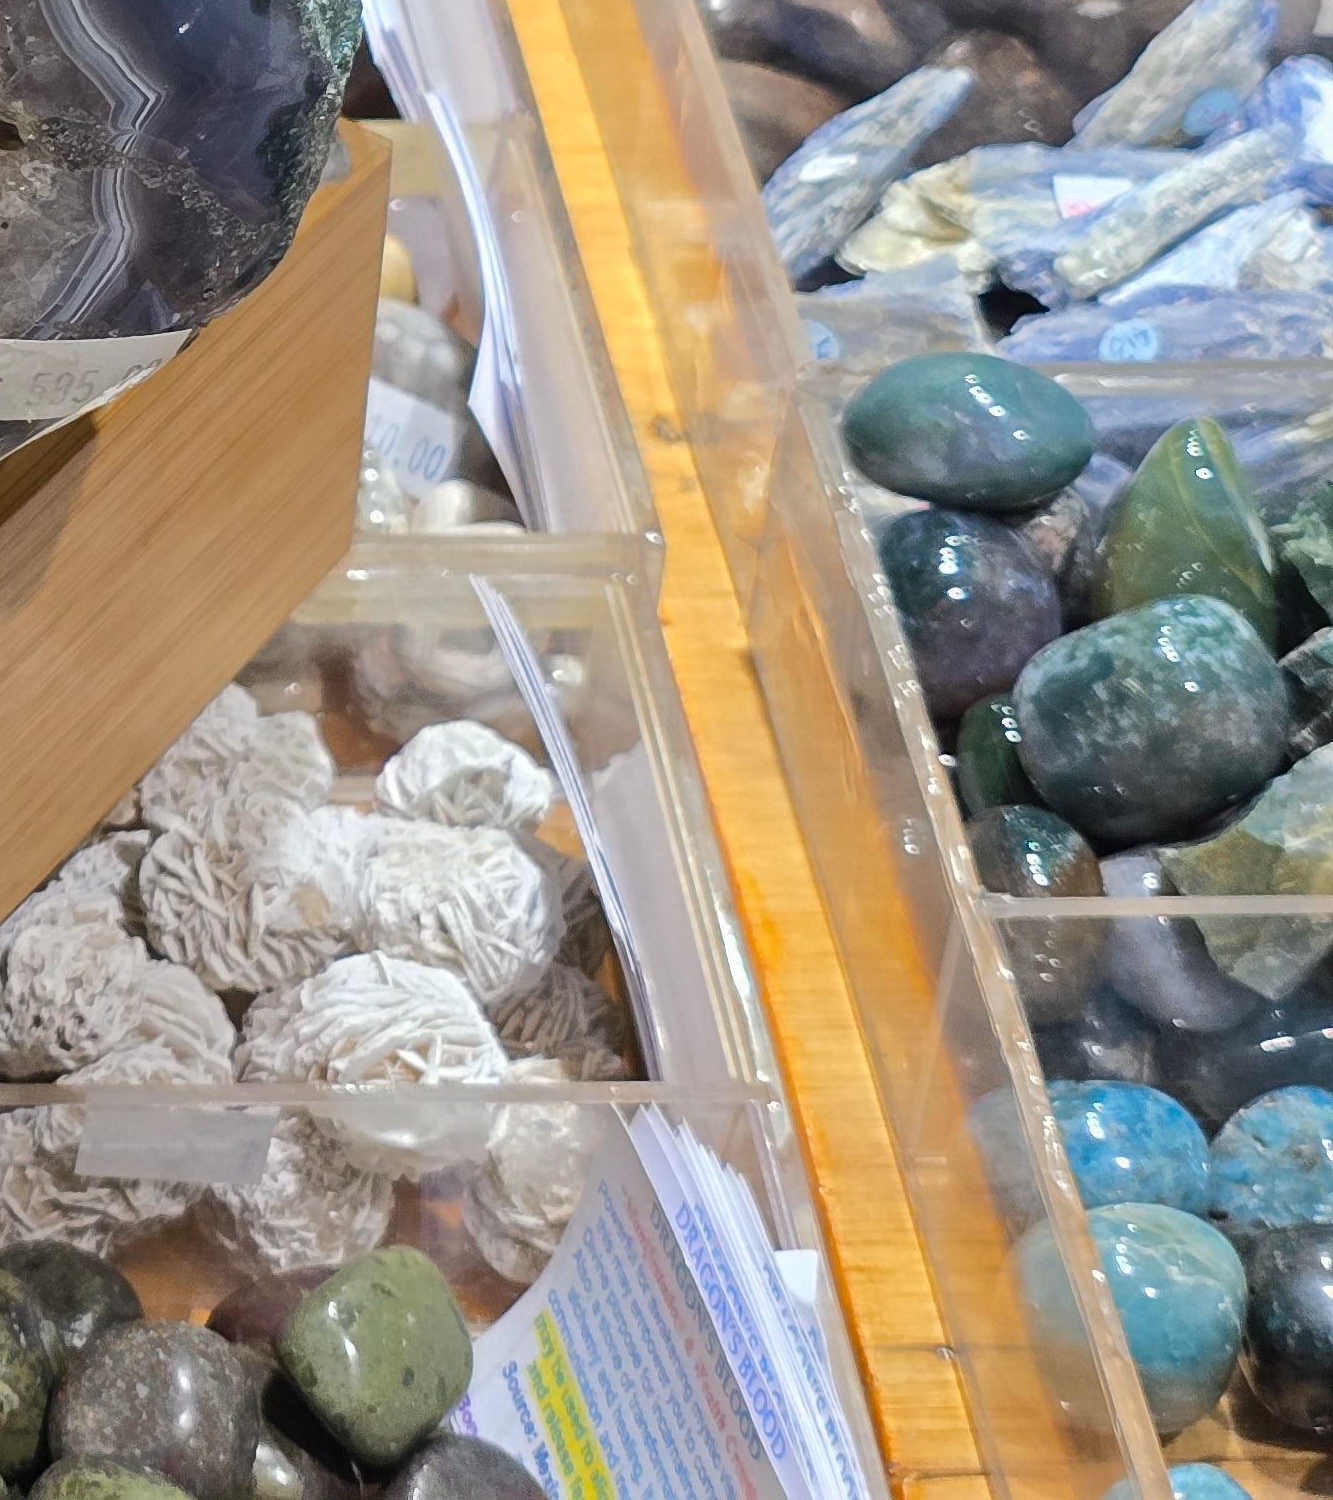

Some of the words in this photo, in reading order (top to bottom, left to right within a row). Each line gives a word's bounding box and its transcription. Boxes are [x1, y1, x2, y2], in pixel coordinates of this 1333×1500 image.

[675, 1203, 742, 1355] DRAGON'S
[737, 1354, 786, 1460] BLOOD
[503, 1360, 537, 1443] Source:
[527, 1360, 549, 1399] and
[534, 1315, 555, 1359] may
[550, 1356, 566, 1388] be
[562, 1389, 587, 1442] used
[581, 1443, 595, 1468] to
[666, 1392, 688, 1432] you
[715, 1354, 761, 1461] BLOOD
[599, 1432, 621, 1472] and
